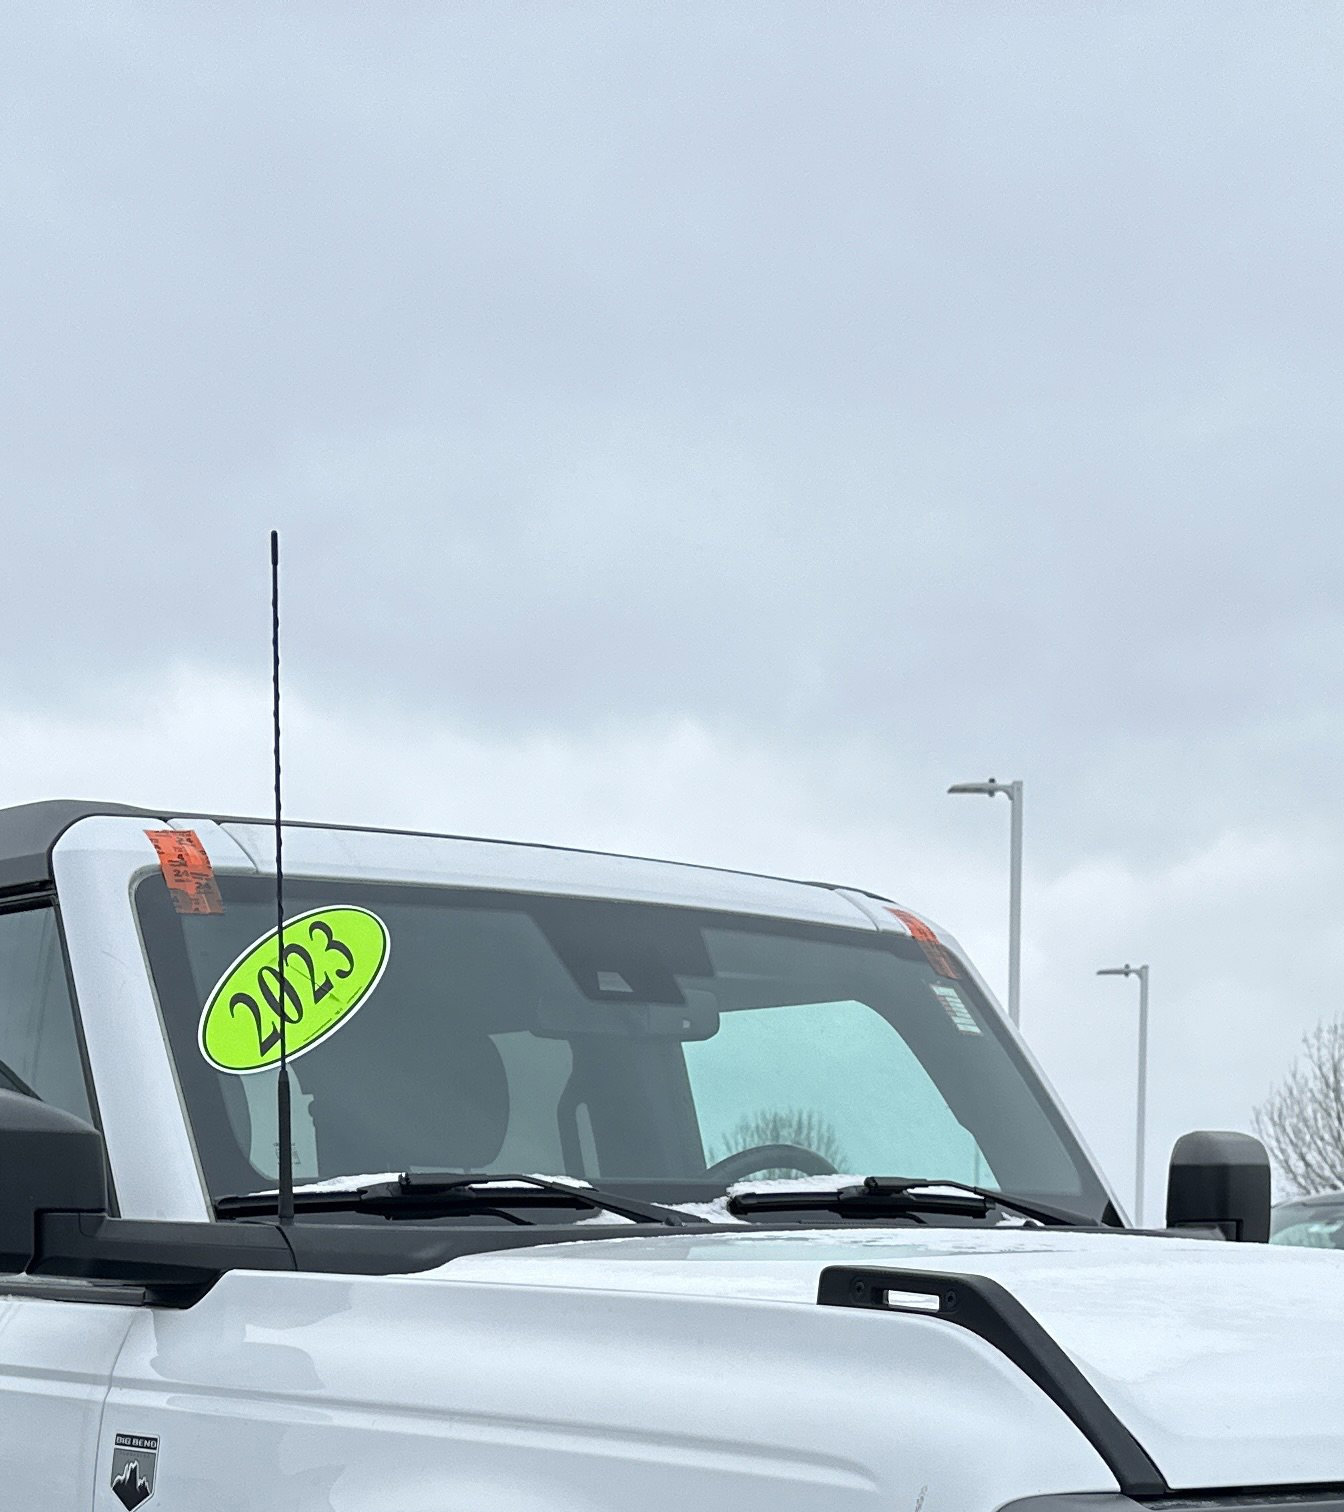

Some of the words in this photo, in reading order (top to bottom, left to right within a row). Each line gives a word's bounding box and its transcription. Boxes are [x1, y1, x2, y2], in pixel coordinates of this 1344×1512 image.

[229, 920, 355, 1057] 2023
[116, 1436, 131, 1445] BIG
[132, 1438, 157, 1448] BEND
